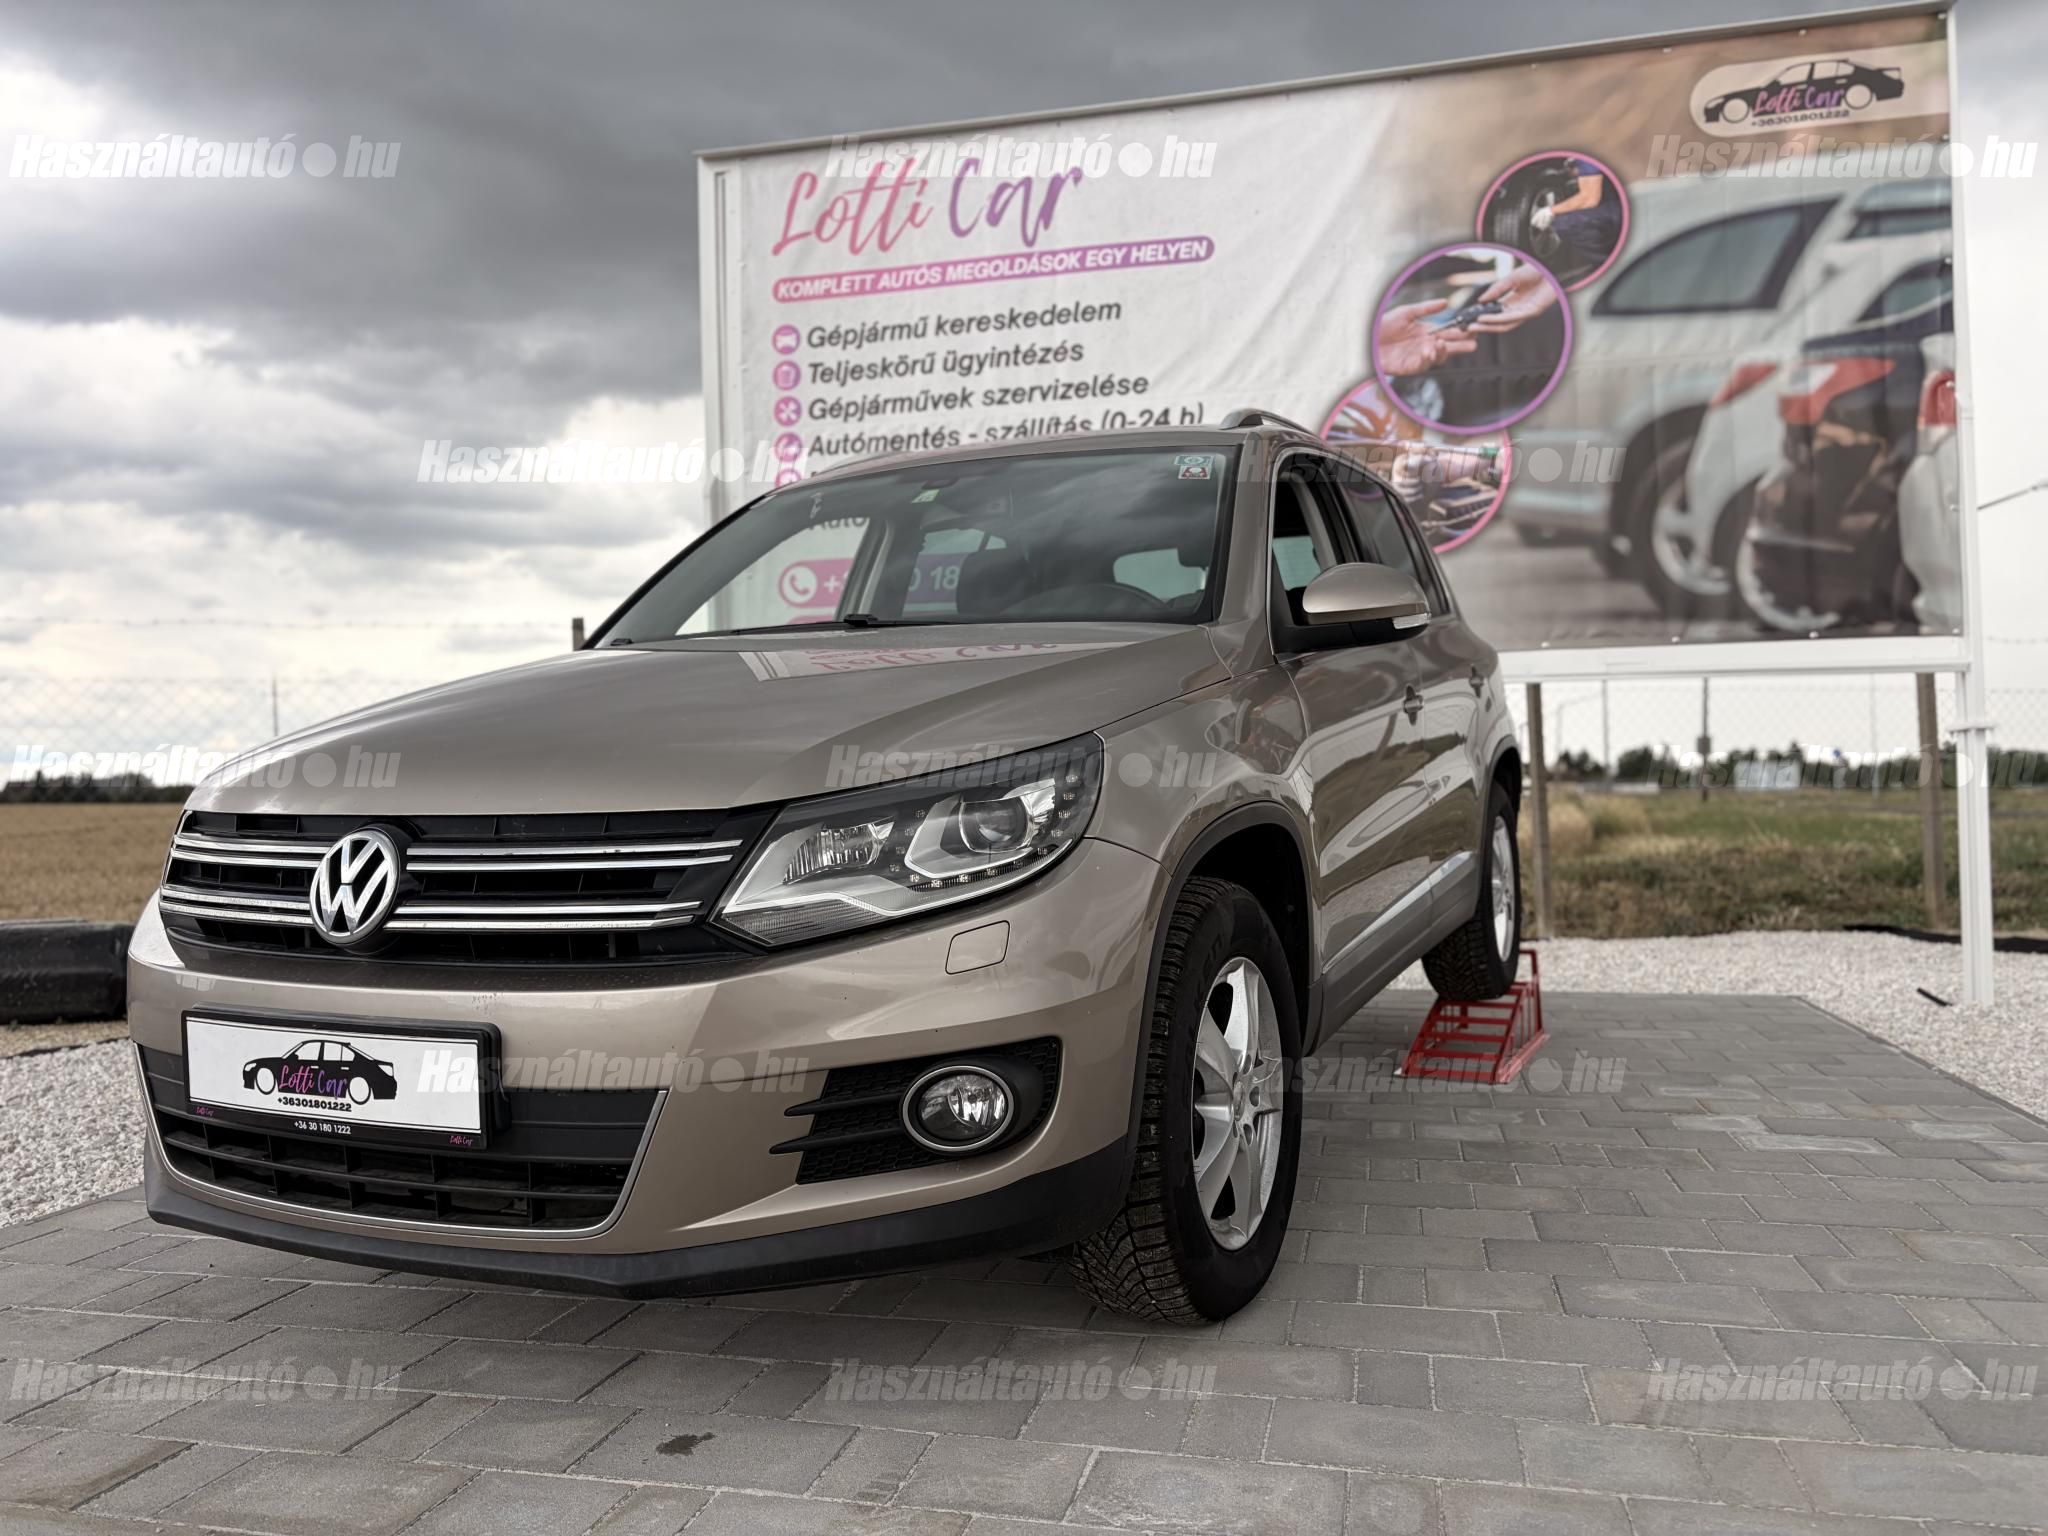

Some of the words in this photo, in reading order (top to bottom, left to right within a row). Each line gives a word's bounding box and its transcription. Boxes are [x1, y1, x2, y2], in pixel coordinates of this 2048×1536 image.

[1753, 86, 1800, 114] Lotti
[1804, 85, 1845, 112] Car
[771, 157, 933, 256] Lotti
[948, 157, 1083, 248] Car
[777, 276, 874, 299] KOMPLETT
[877, 267, 942, 290] AUTÓS
[945, 251, 1082, 283] MEGOLDÁSOK
[1084, 247, 1126, 268] EGY
[1130, 240, 1208, 264] HELYEN
[806, 316, 928, 351] Gépjármű
[935, 303, 1122, 337] kereskedelem
[942, 341, 1084, 375] ügyintézés
[808, 384, 974, 423] Gépjárművek
[981, 373, 1149, 406] szervizelése
[808, 426, 961, 458] Autómentés
[279, 1065, 315, 1093] Lotti
[317, 1069, 348, 1100] Car
[277, 1096, 352, 1113] +36301801222
[294, 1120, 307, 1130] +36
[308, 1121, 318, 1131] 30
[319, 1123, 332, 1132] 180
[333, 1124, 352, 1135] 1222
